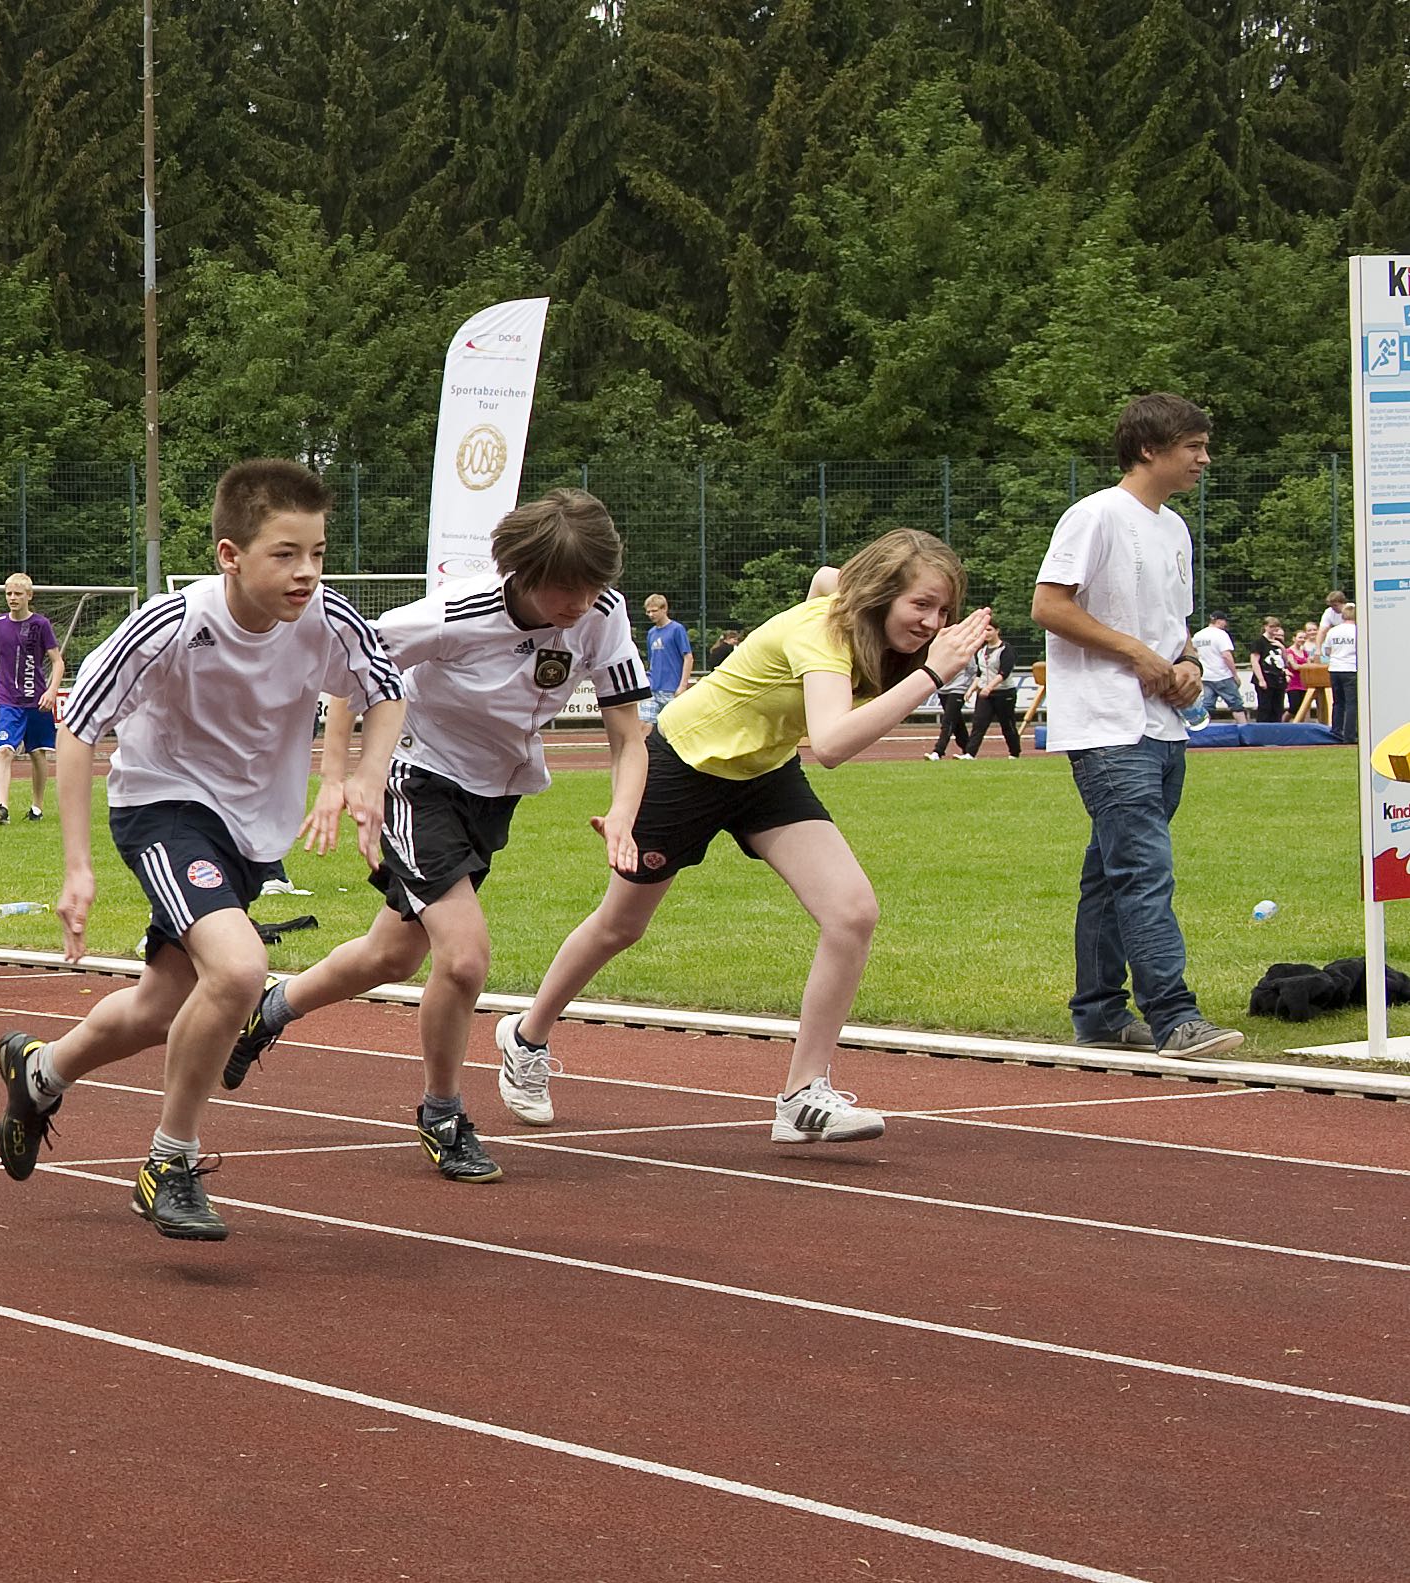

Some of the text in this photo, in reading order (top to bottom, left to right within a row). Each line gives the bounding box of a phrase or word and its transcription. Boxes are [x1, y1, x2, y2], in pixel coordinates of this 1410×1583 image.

[498, 334, 522, 343] DOSB
[478, 400, 500, 411] Tour
[460, 439, 500, 475] DOSB
[1383, 802, 1410, 820] kind
